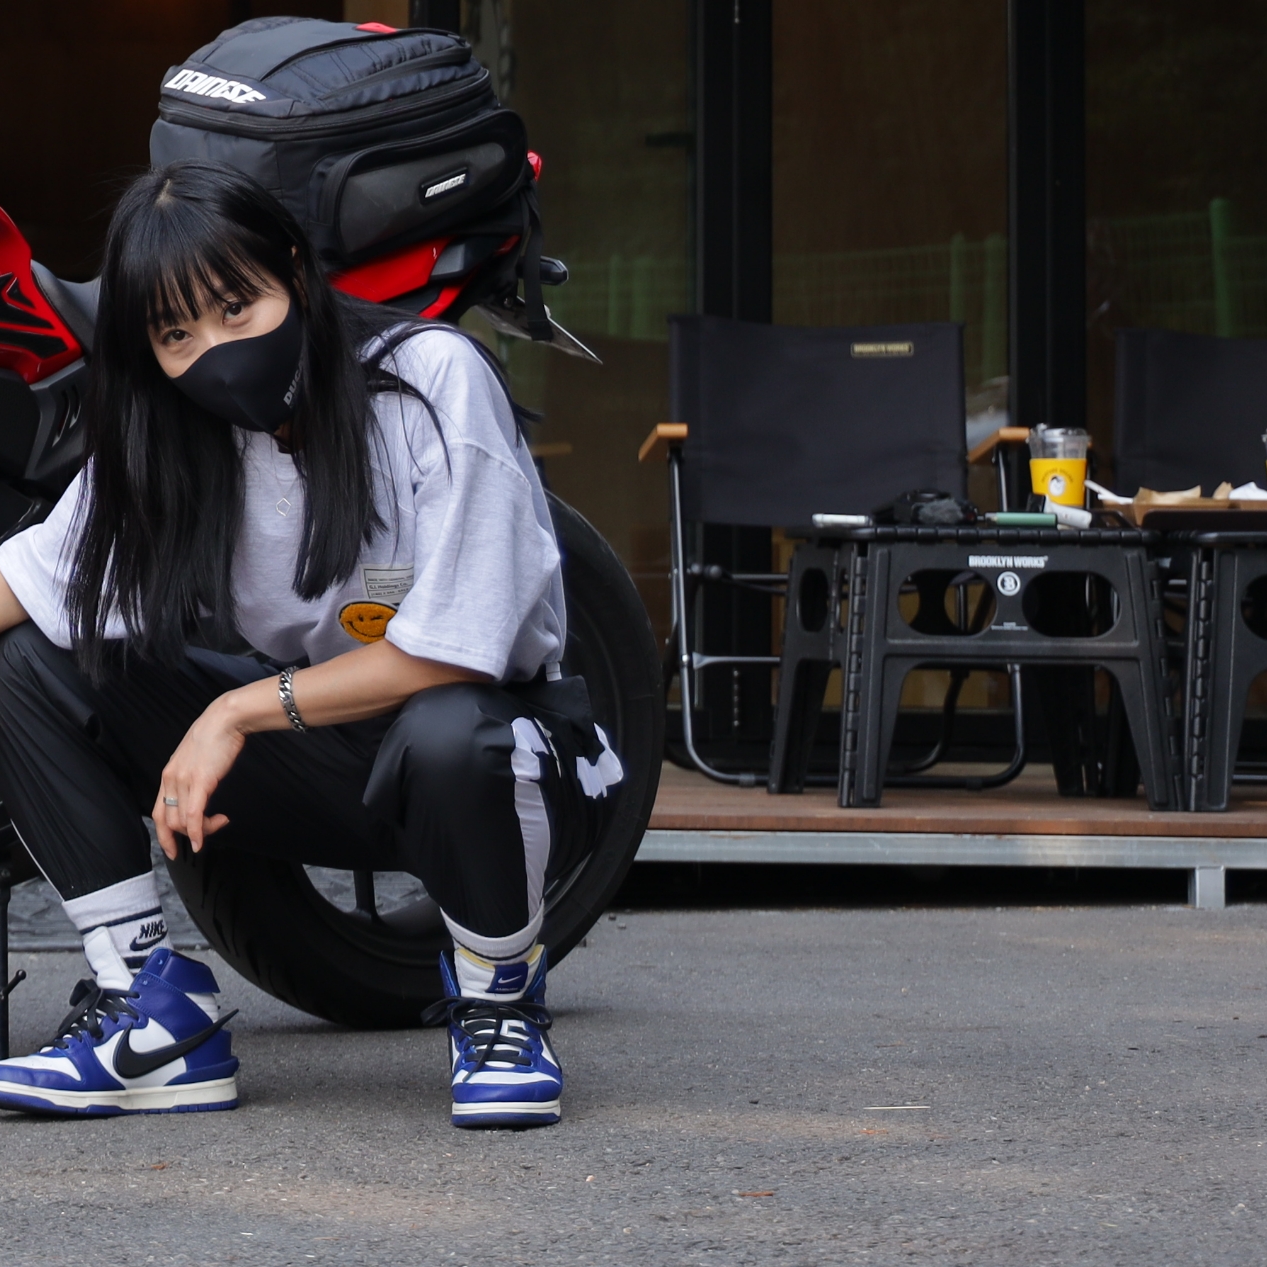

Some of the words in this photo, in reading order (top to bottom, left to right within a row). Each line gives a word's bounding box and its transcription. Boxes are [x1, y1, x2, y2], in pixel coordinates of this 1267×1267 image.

[164, 69, 266, 104] DAINESE
[968, 554, 1013, 568] BROOKLYN
[139, 919, 164, 940] NIKE
